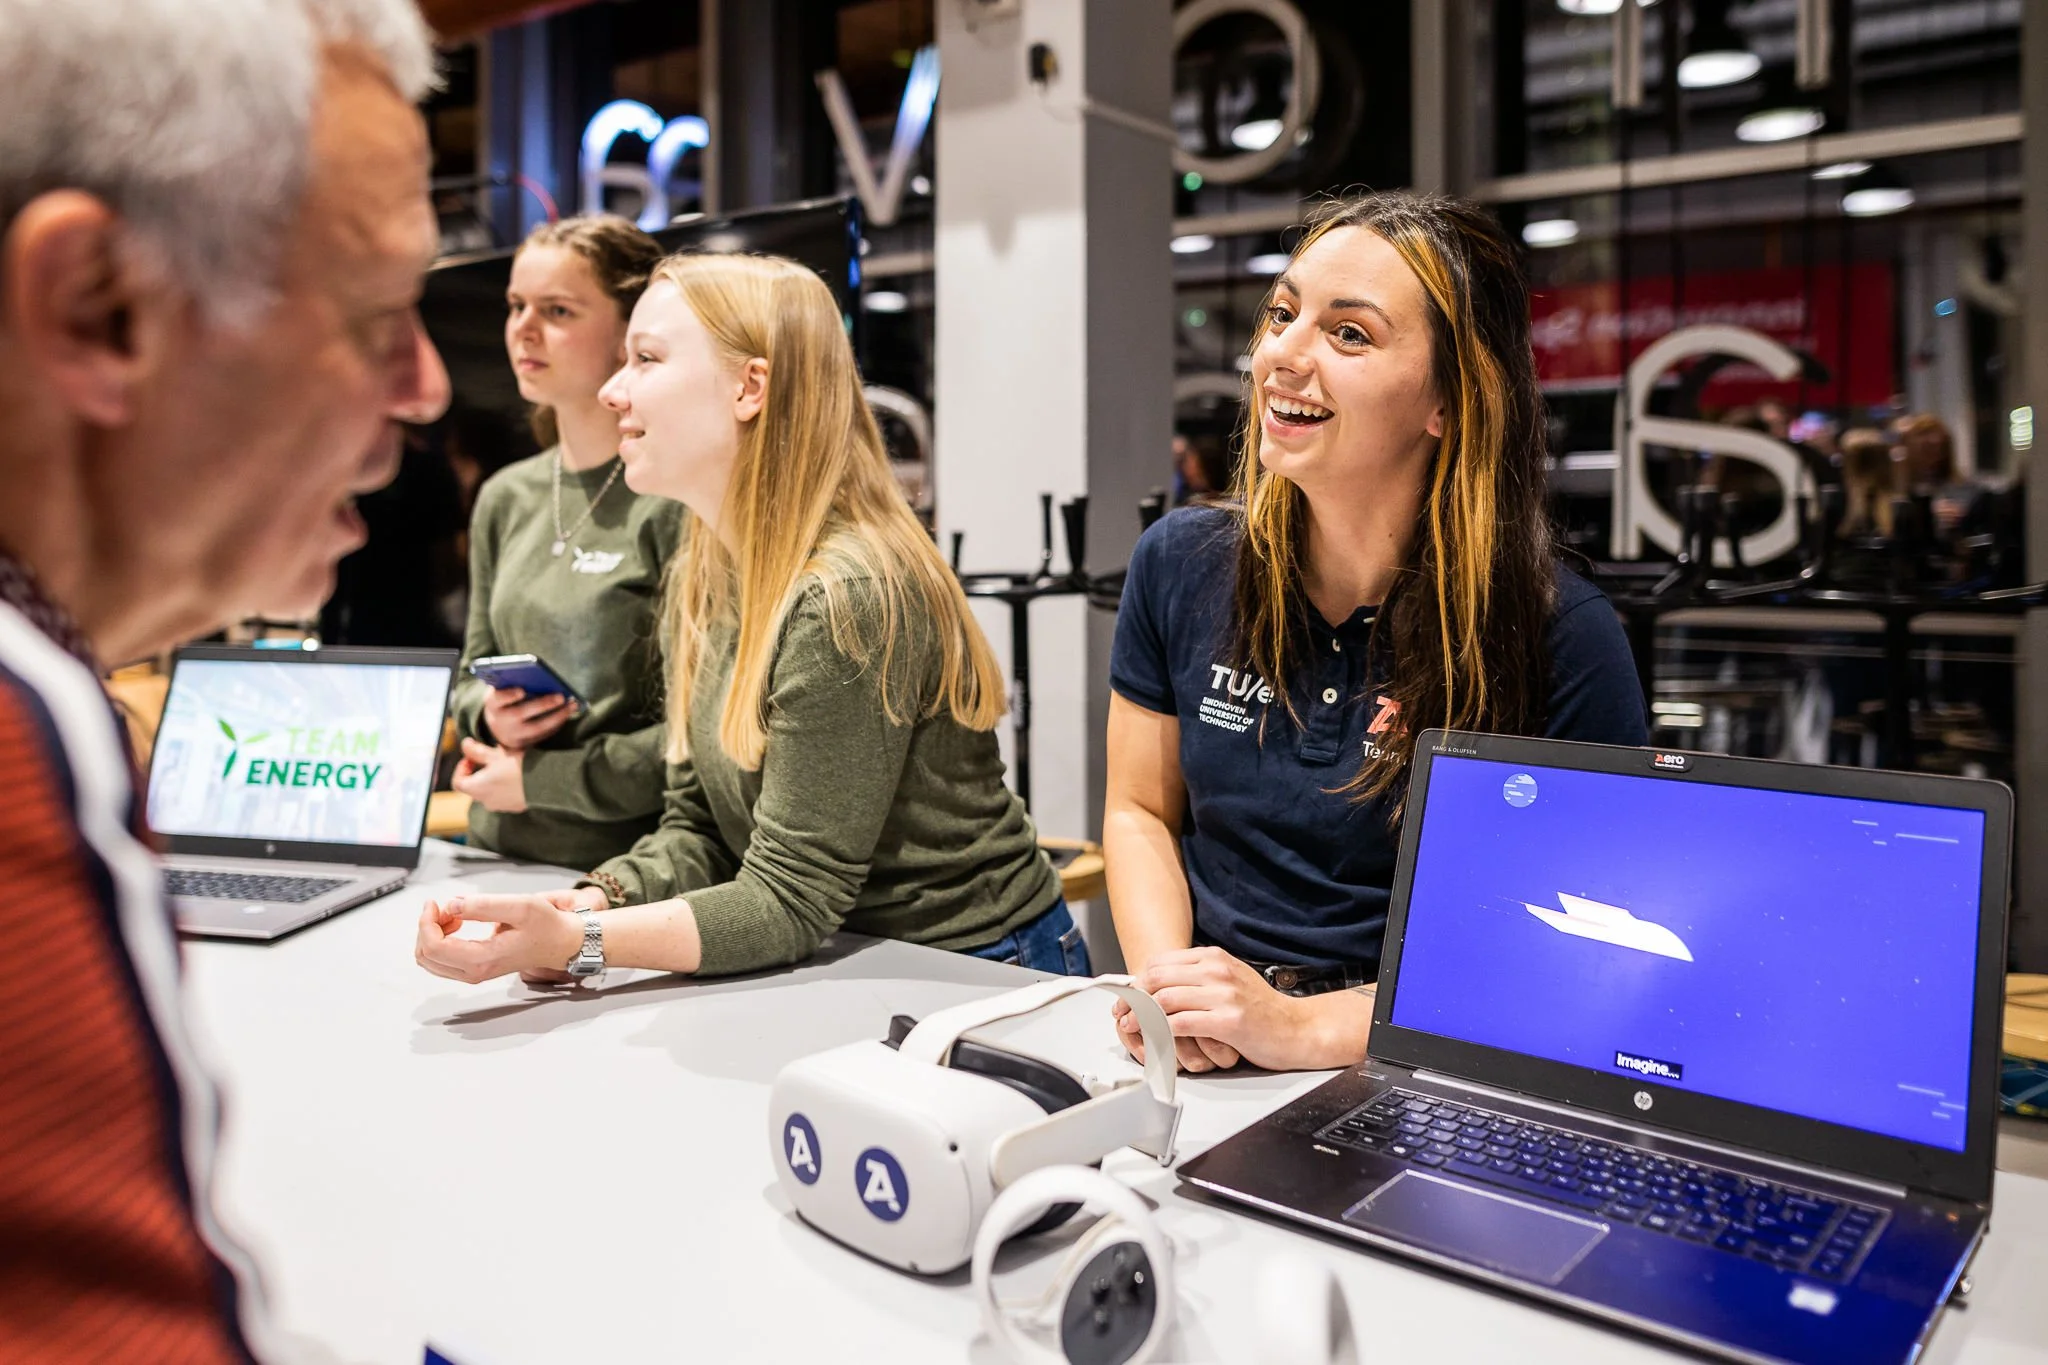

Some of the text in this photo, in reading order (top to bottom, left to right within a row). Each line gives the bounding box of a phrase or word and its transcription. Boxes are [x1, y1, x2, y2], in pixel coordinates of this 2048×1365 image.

[1211, 663, 1275, 704] TU/e
[1200, 704, 1254, 726] UNIVERSITY OF
[1202, 696, 1246, 715] EINDHOVEN
[1198, 713, 1247, 733] TECHNOLOGY
[286, 726, 382, 756] TEAM
[246, 759, 382, 790] ENERGY
[1616, 1052, 1680, 1080] Imagine...
